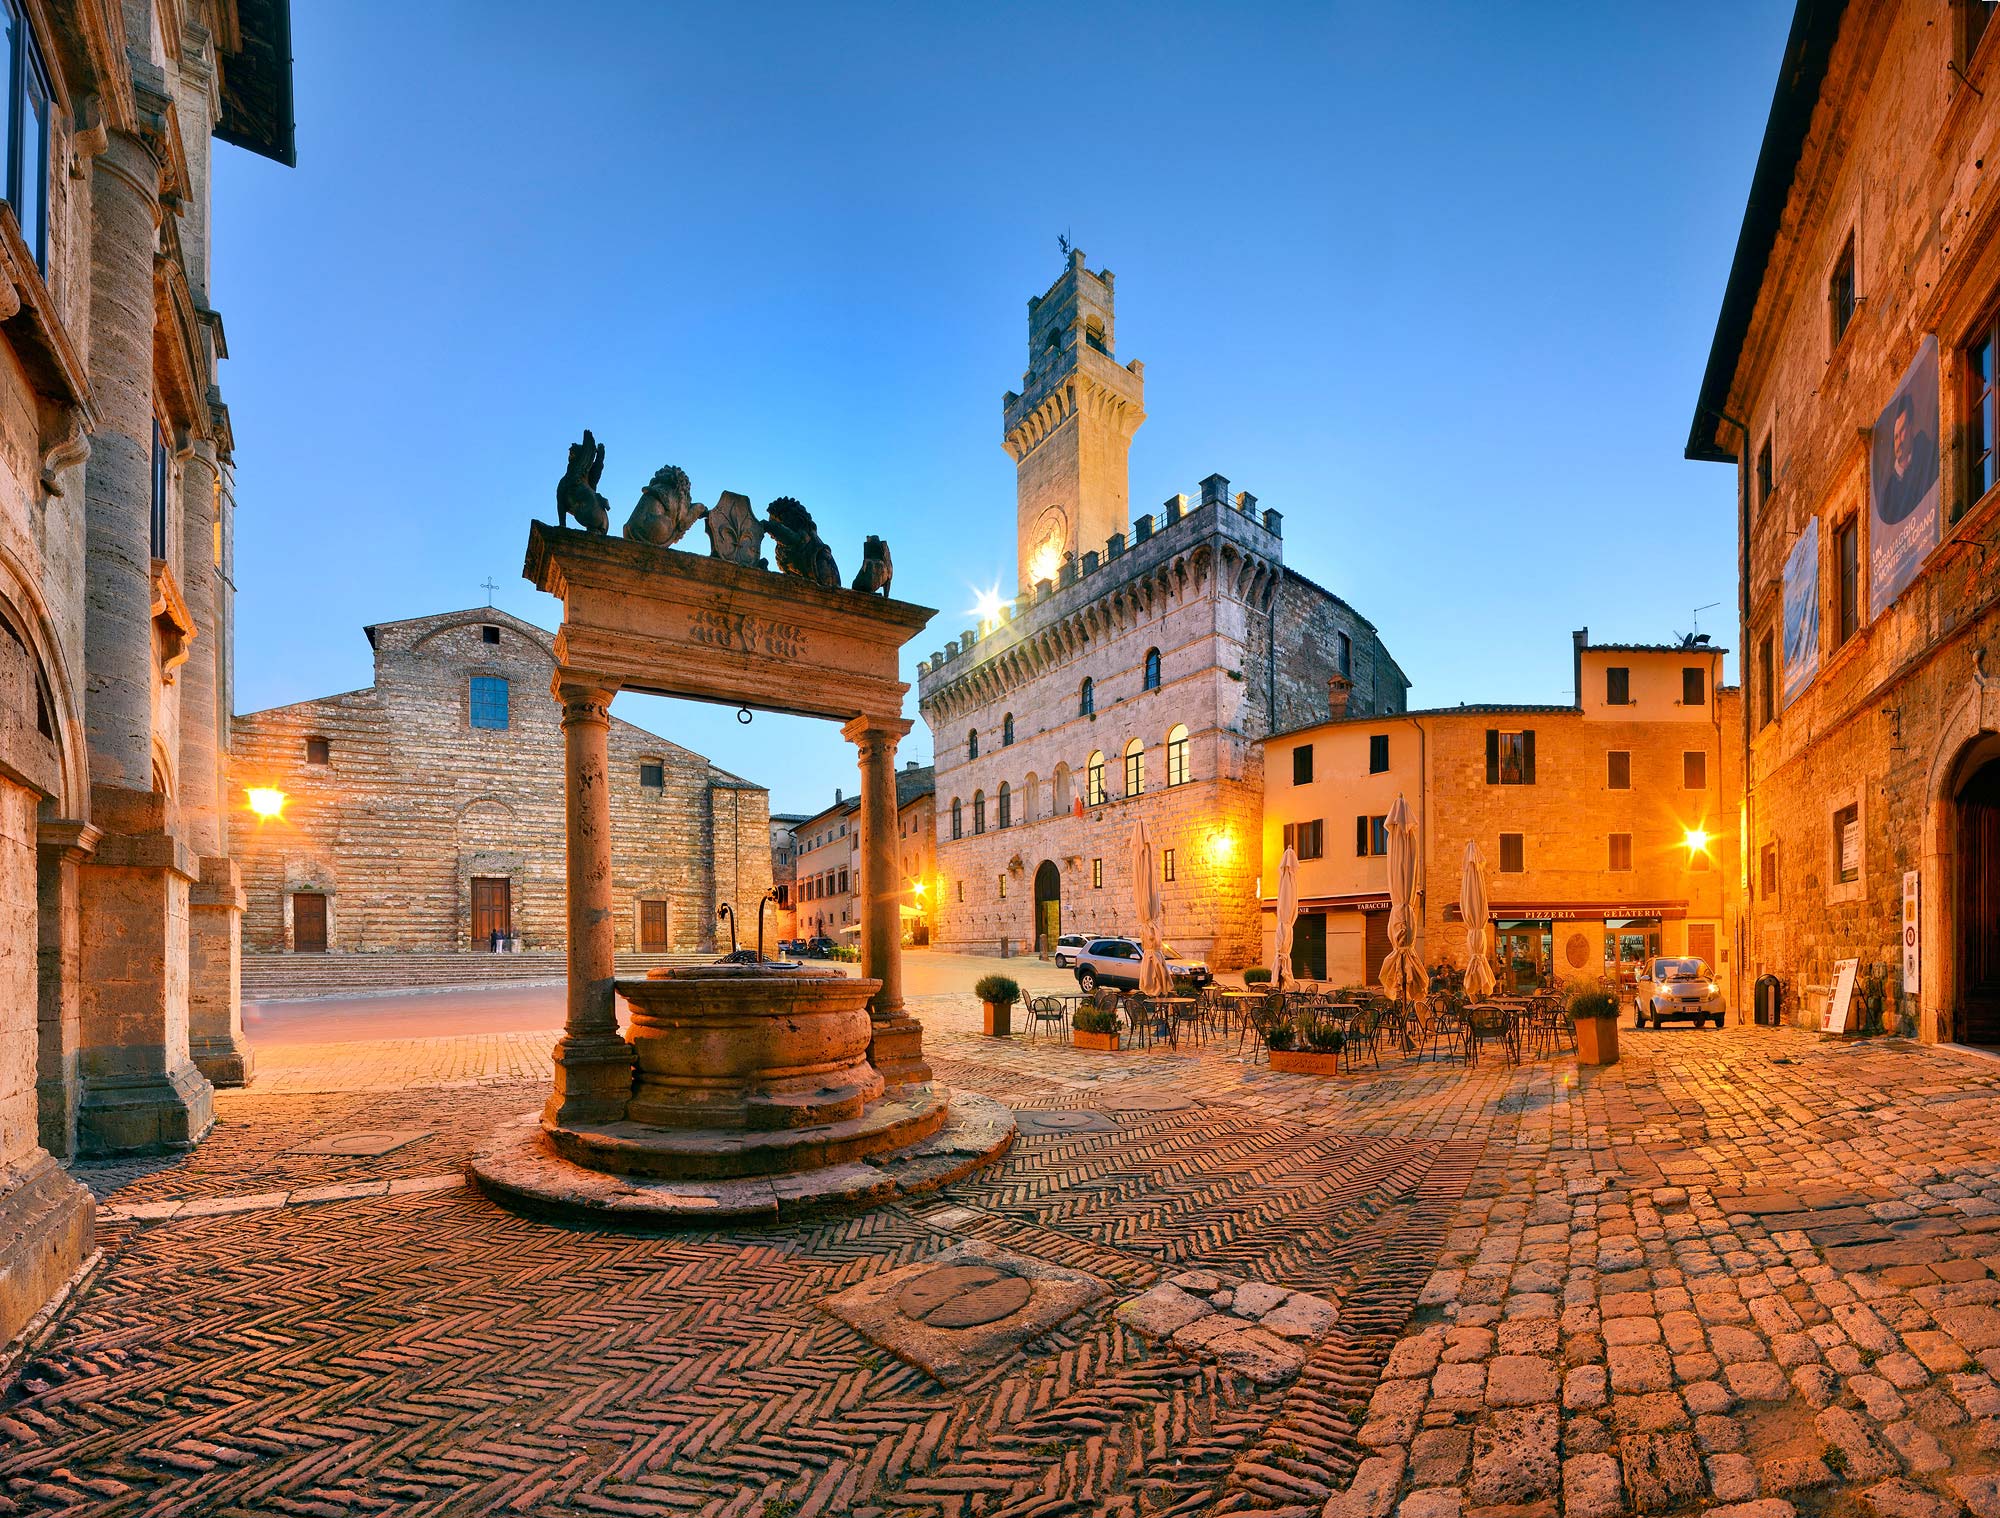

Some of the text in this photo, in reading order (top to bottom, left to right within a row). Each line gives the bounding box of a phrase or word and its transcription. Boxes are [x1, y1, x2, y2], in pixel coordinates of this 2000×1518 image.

[1873, 517, 1916, 576] CARAVAGGIO
[1873, 545, 1882, 563] UN
[1357, 902, 1389, 910] TABACCHI
[1525, 911, 1576, 919] PIZZERIA
